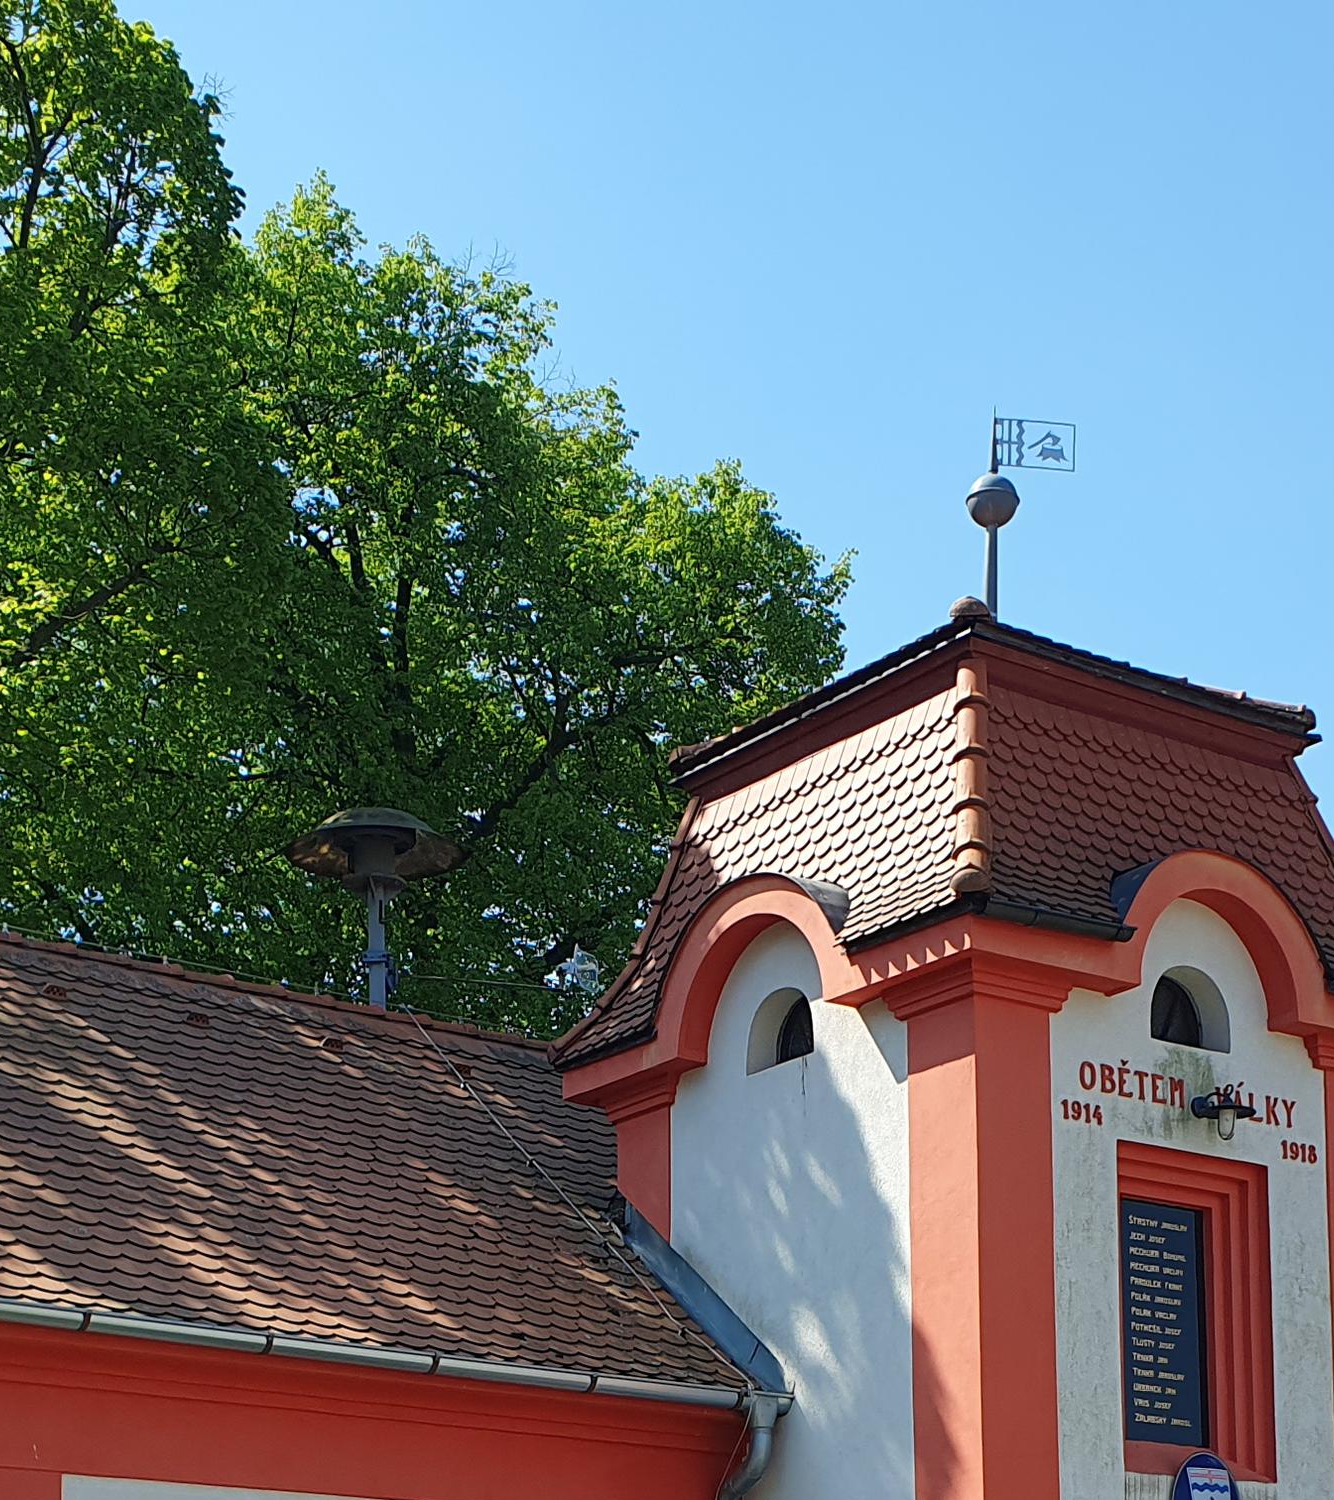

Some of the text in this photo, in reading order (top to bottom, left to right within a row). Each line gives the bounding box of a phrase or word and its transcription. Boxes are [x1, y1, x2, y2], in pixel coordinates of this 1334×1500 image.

[1079, 1059, 1185, 1109] OBĚTEM
[1060, 1099, 1103, 1126] 1914
[1280, 1139, 1318, 1164] 1918
